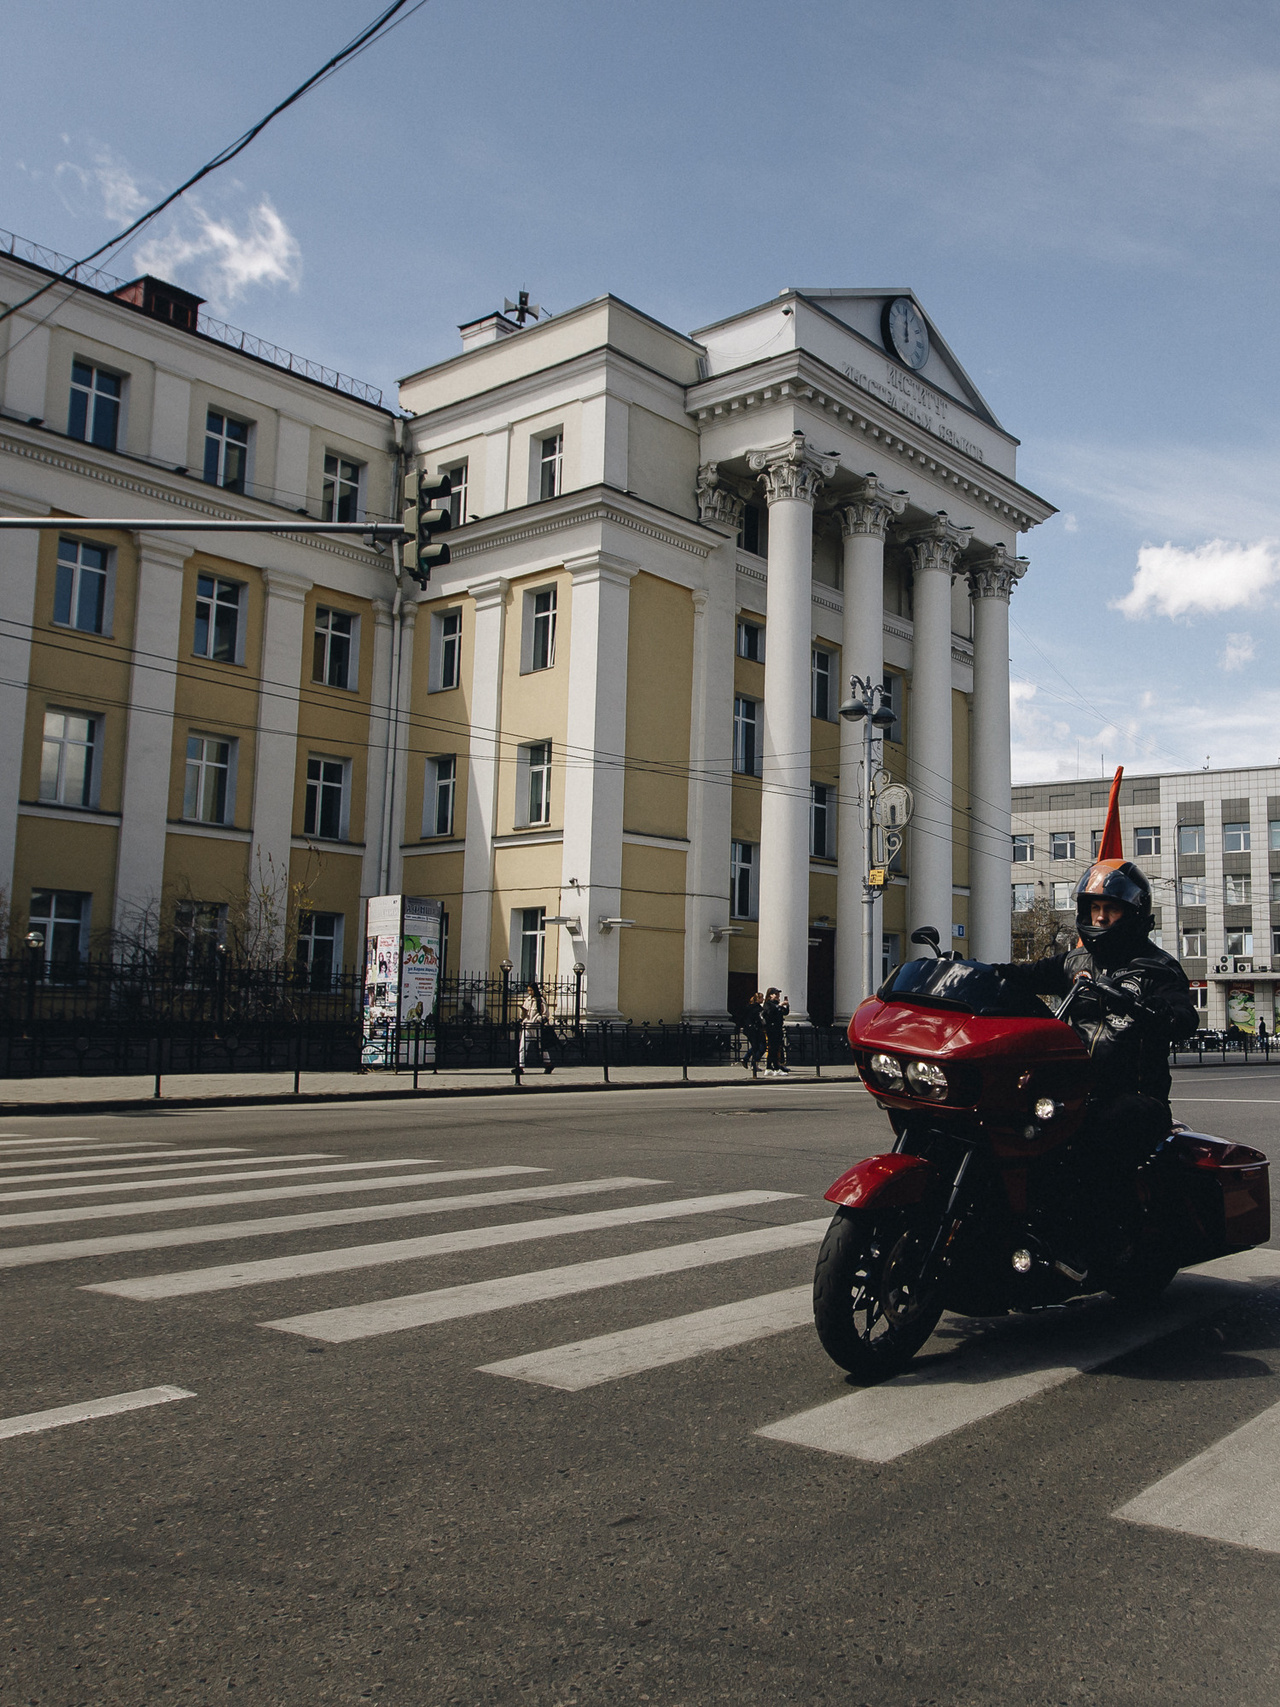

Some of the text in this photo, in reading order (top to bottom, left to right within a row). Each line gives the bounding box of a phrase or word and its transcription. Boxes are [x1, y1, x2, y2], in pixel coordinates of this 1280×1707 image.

[841, 361, 984, 463] ИНОСТРАННЫХ ЯЗЫКОВ
[886, 363, 948, 420] ИНСТИТУТ
